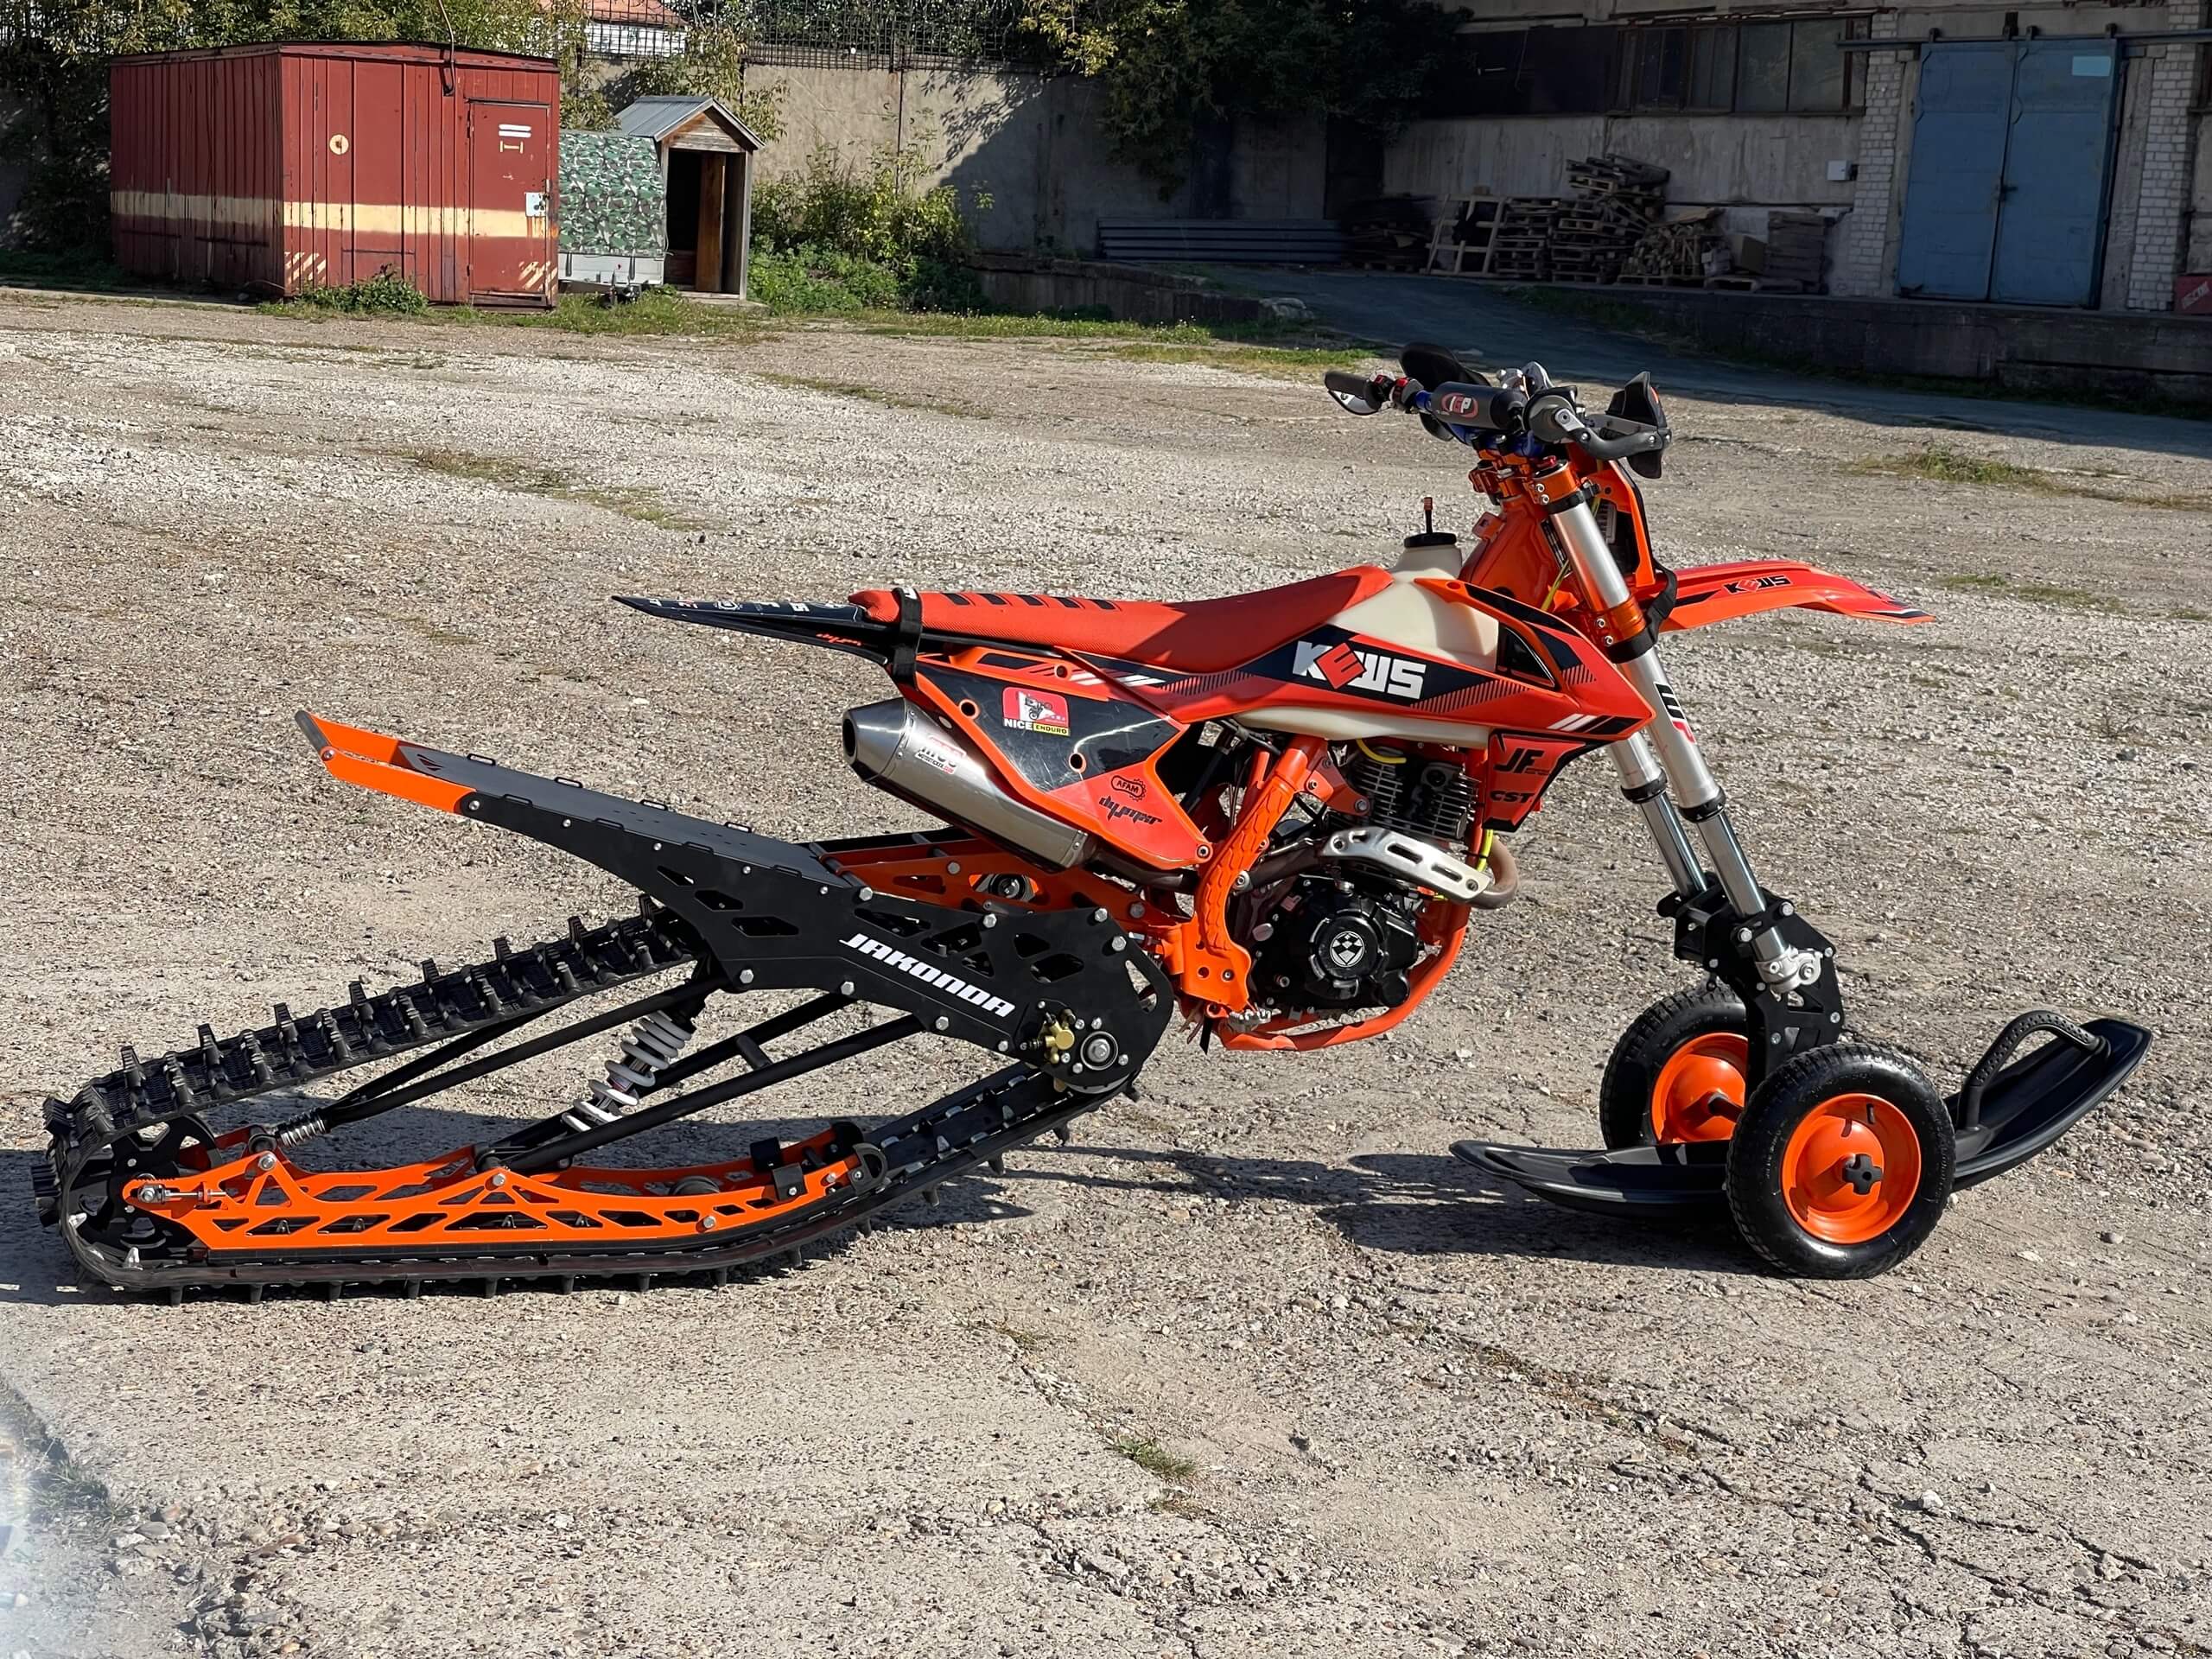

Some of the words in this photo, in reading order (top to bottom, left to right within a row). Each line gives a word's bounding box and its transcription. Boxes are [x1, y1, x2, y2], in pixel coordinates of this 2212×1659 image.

[1724, 575, 1791, 594] KEWS
[1292, 640, 1427, 700] KEWS
[1004, 718, 1033, 730] NICE
[1035, 724, 1067, 734] ENDURO
[1493, 747, 1545, 774] JF
[1116, 779, 1139, 793] AFAM
[1490, 790, 1535, 804] CST
[839, 933, 1015, 1017] JAKONDA
